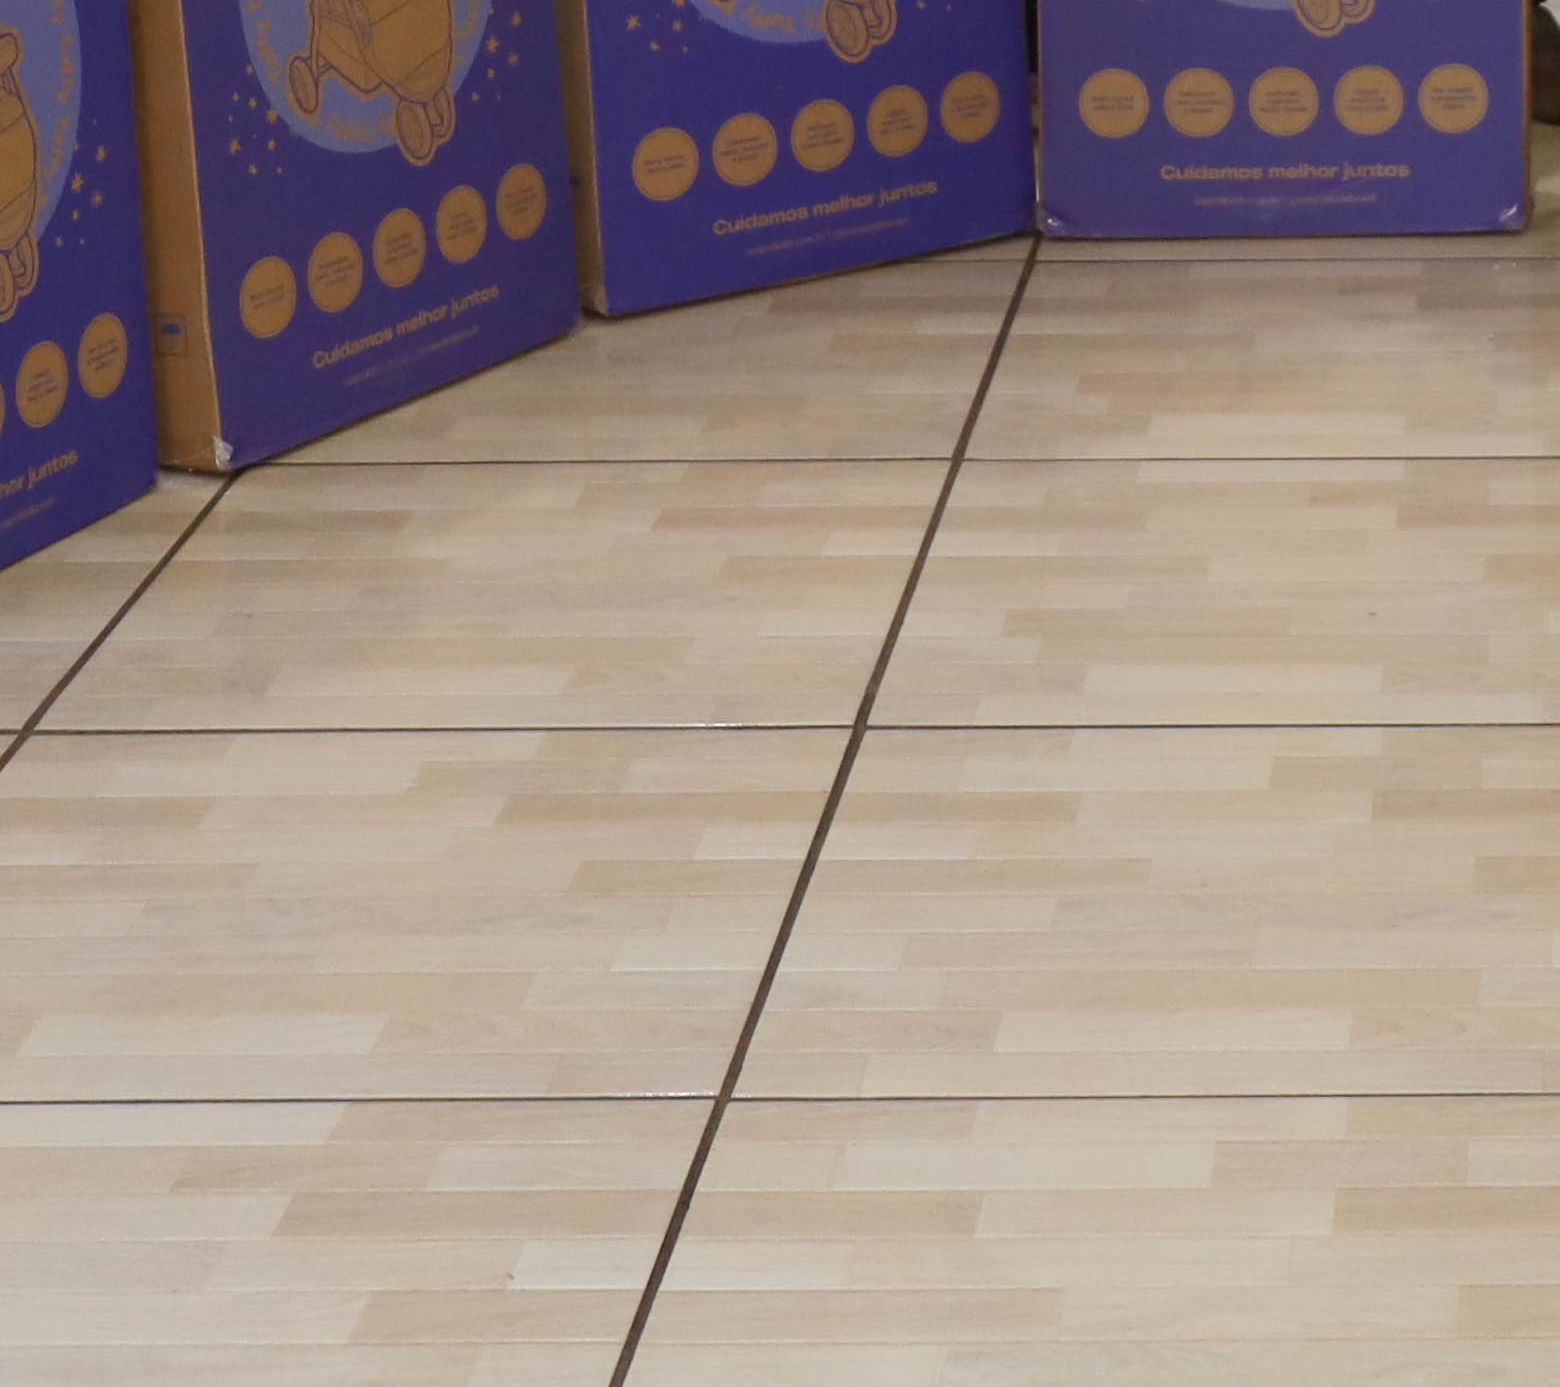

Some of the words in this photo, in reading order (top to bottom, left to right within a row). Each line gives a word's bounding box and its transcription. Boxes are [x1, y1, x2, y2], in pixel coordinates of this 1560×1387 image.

[1161, 164, 1263, 180] Cuidamos
[1268, 163, 1337, 179] melhor
[1343, 163, 1410, 181] juntos
[712, 206, 809, 236] Cuidamos
[812, 192, 875, 217] melhor
[878, 179, 938, 206] juntos
[312, 329, 393, 369] Cuidamos
[396, 304, 448, 340] melhor
[451, 285, 500, 315] juntos
[28, 450, 78, 489] juntos
